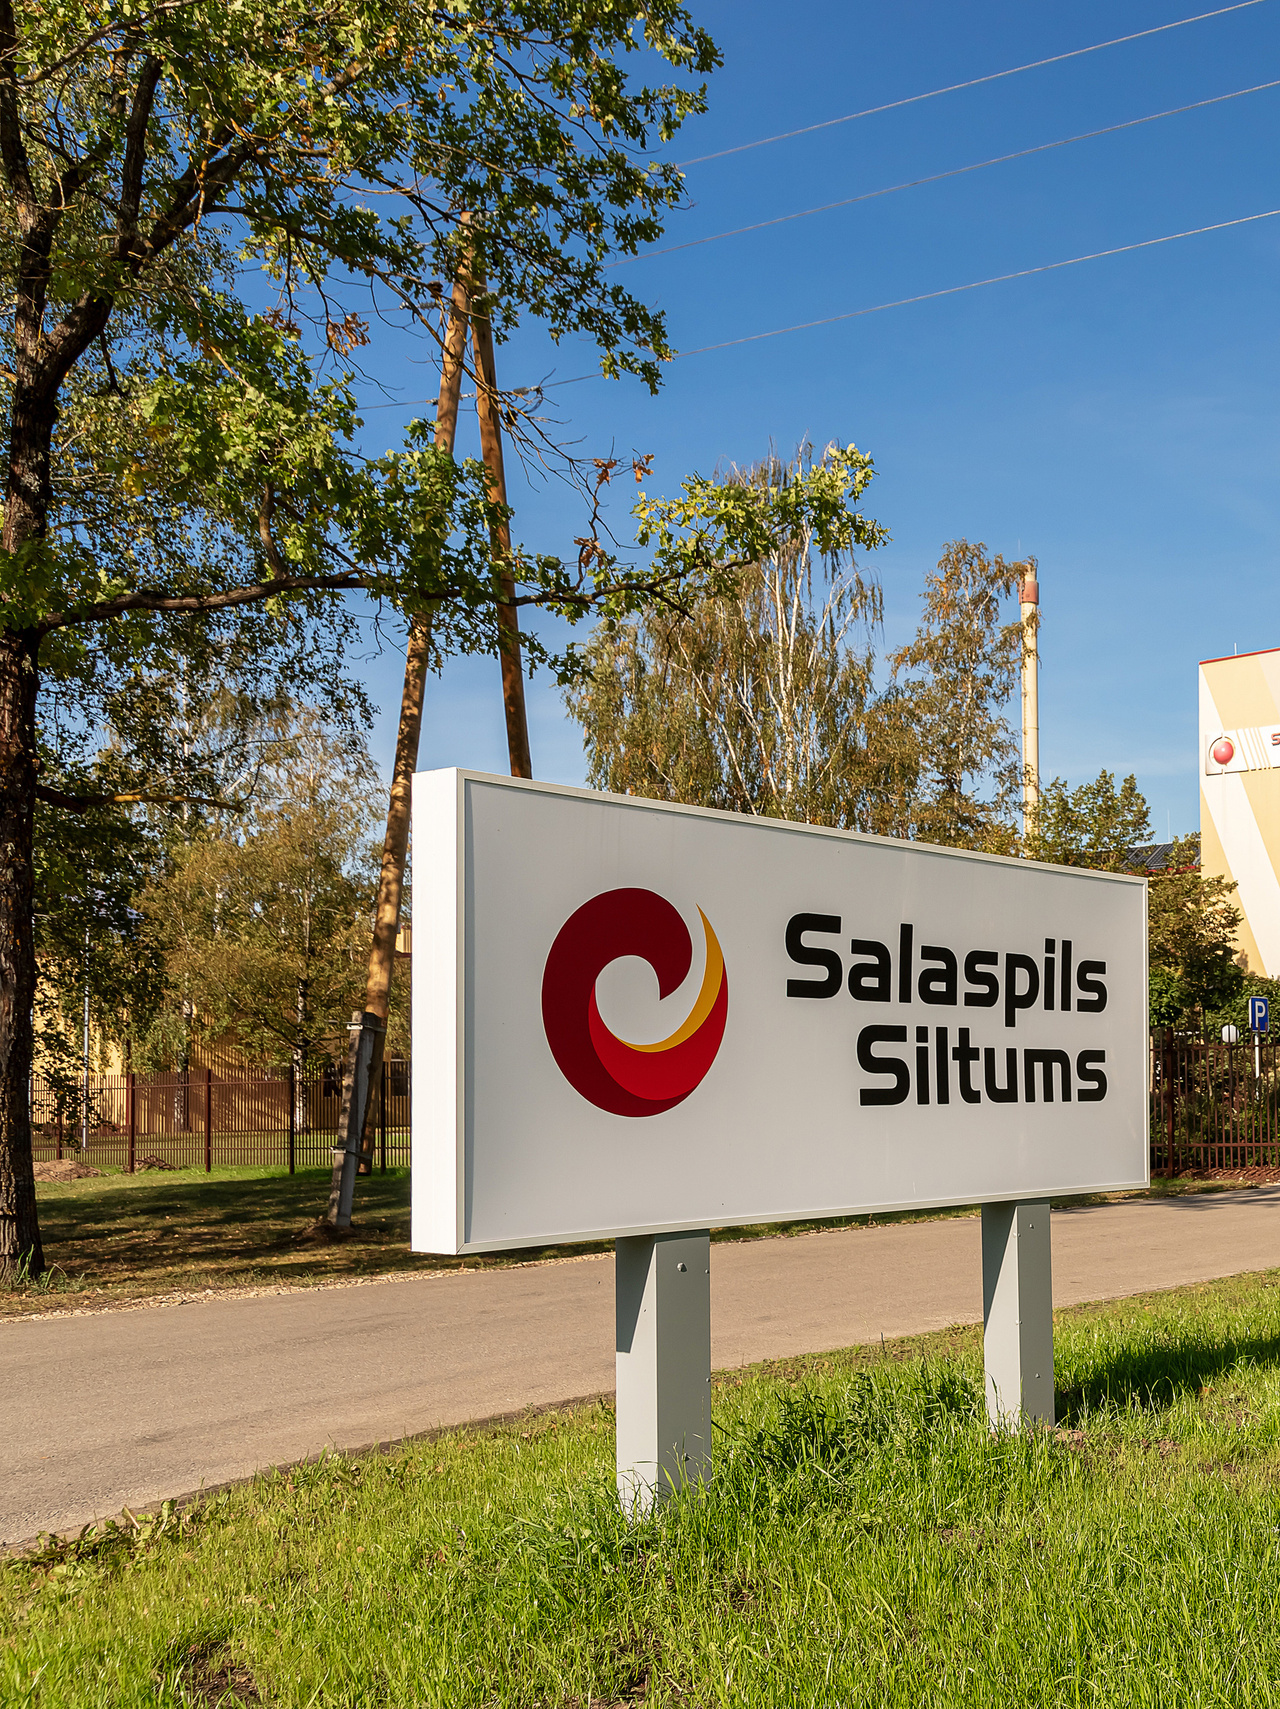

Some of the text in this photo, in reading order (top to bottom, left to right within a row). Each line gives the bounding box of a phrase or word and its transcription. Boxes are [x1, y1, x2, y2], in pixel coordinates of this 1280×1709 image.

[785, 912, 1108, 1028] Salaspils
[1255, 1001, 1266, 1028] P
[856, 1024, 1108, 1107] Siltums
